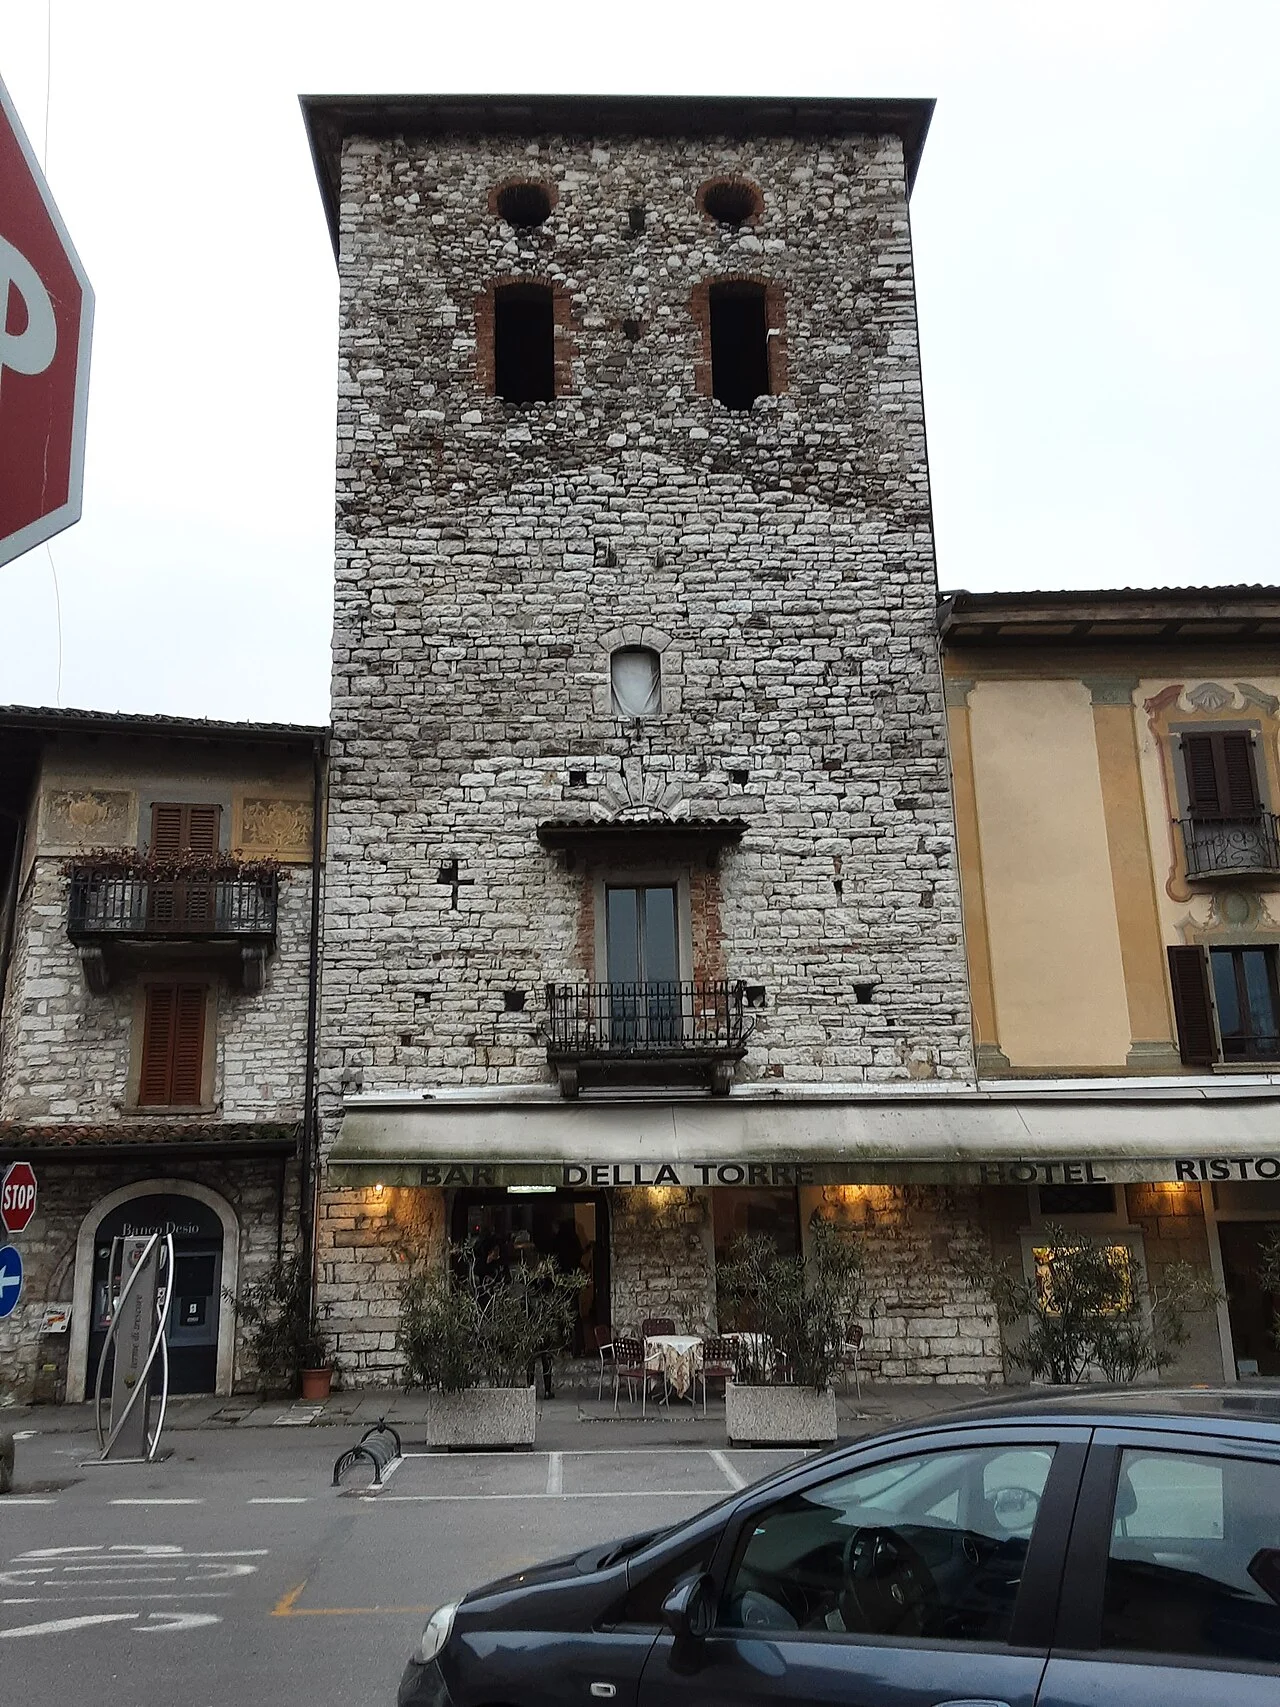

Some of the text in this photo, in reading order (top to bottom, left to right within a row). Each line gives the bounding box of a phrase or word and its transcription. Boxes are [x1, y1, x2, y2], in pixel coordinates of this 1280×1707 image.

[420, 1164, 496, 1186] BAR
[563, 1163, 814, 1186] DELLA TORRE
[979, 1161, 1106, 1184] HOTEL
[3, 1184, 34, 1210] STOP
[122, 1221, 200, 1236] Banco Desio
